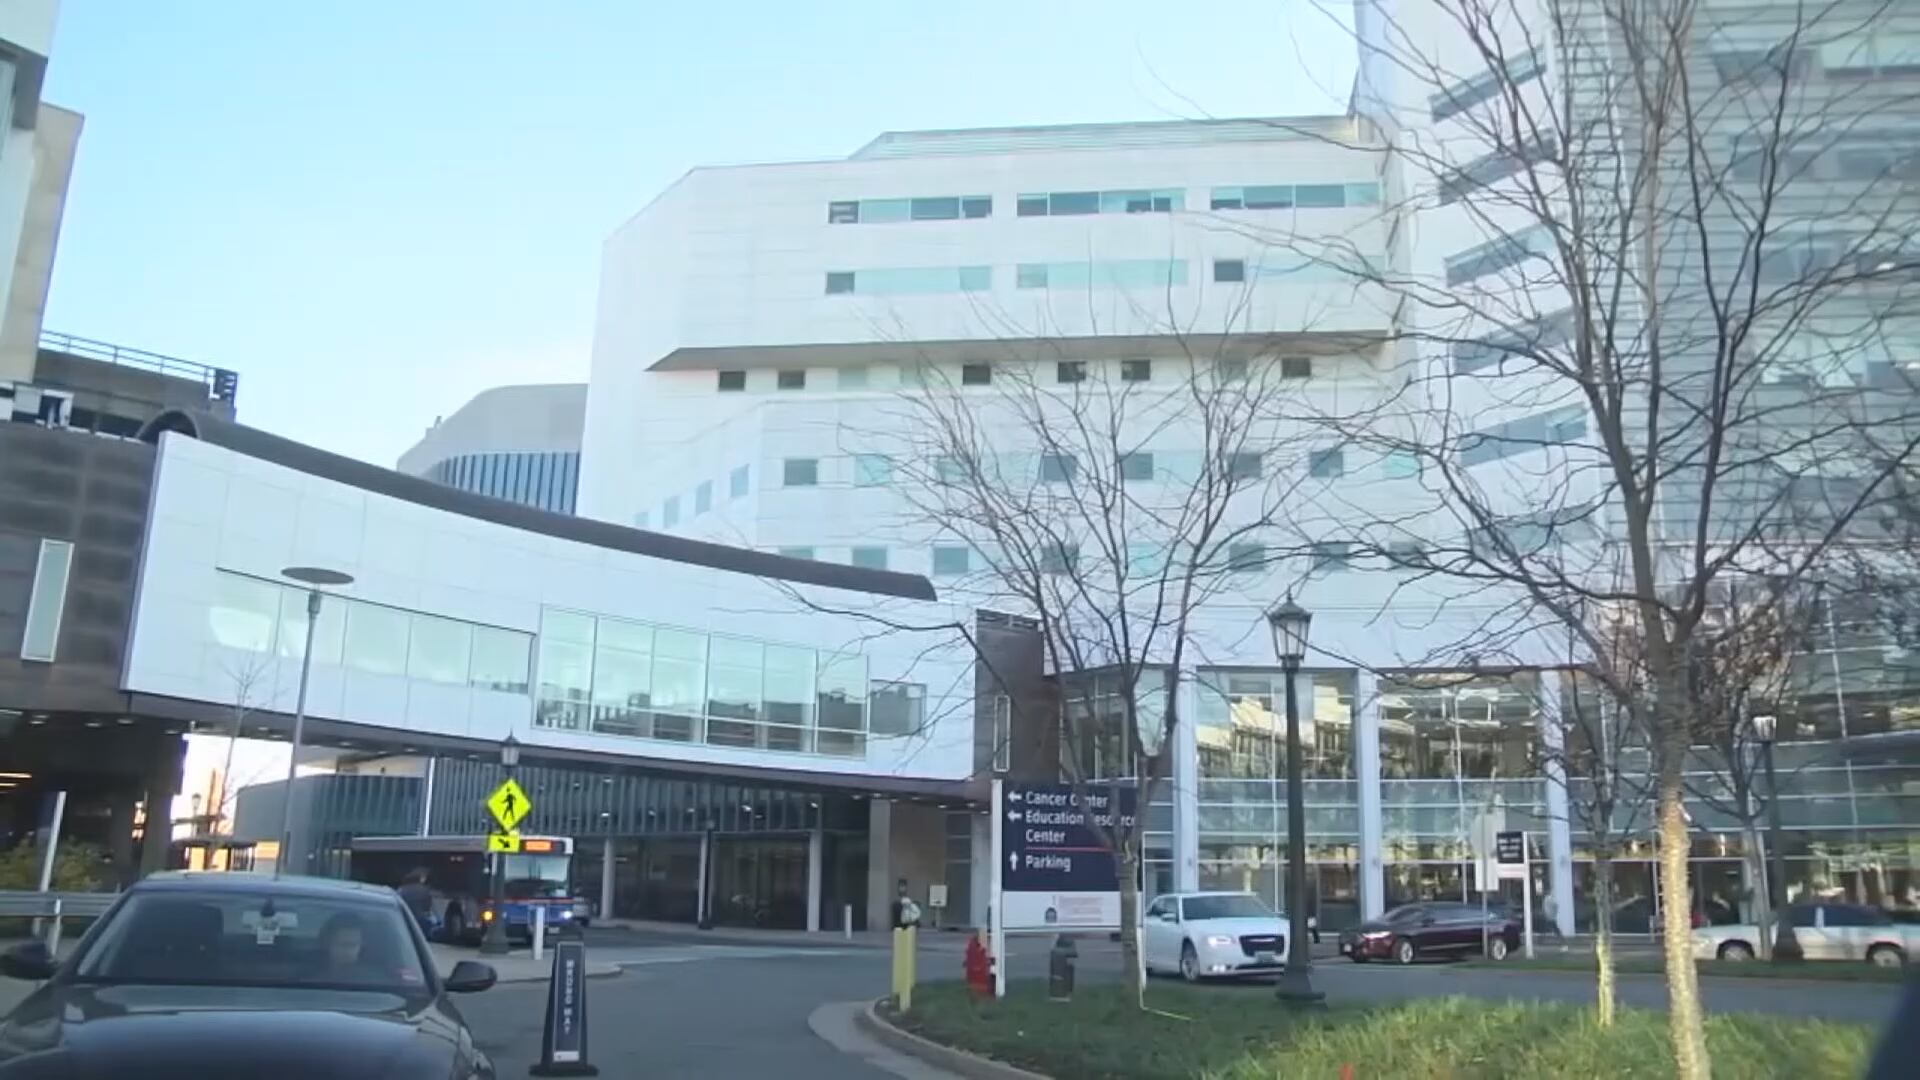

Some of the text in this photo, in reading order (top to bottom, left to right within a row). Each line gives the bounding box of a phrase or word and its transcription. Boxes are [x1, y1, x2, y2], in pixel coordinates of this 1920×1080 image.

[1025, 791, 1108, 808] Cancer Cnter
[1025, 809, 1084, 824] Education
[1025, 829, 1066, 843] Center
[1025, 855, 1071, 872] Parking
